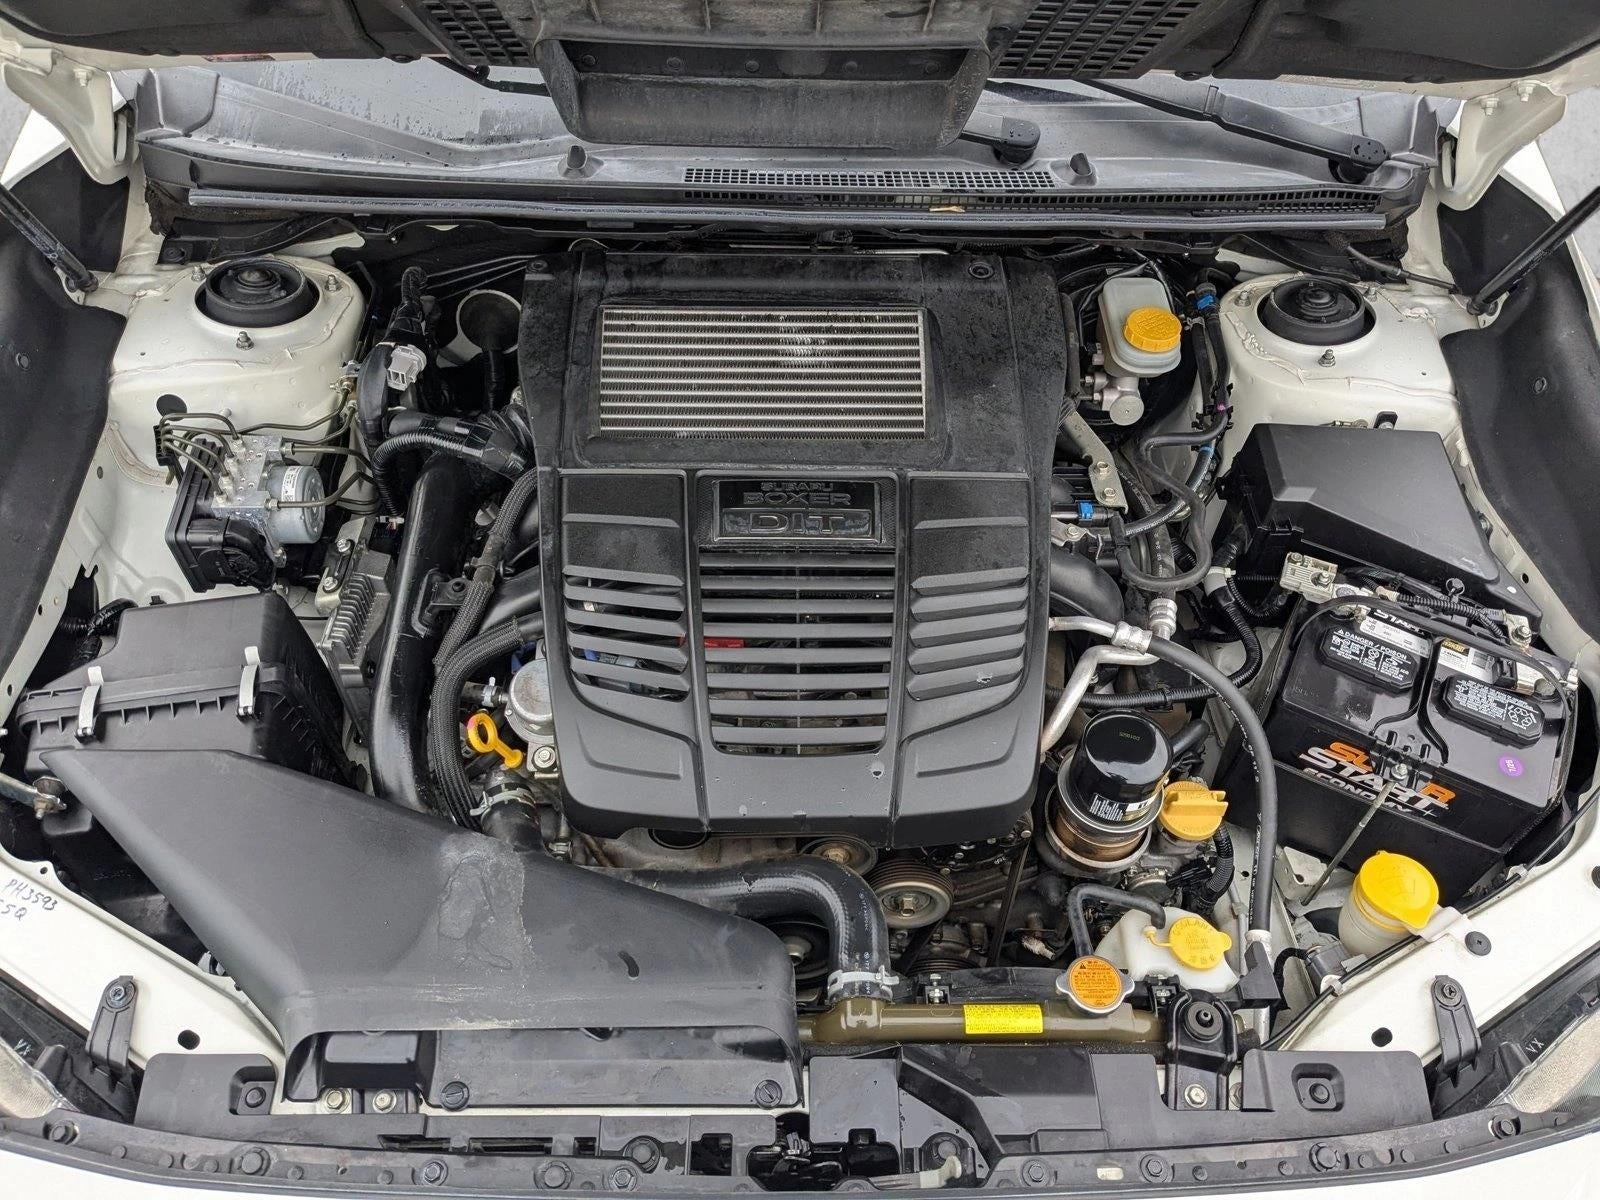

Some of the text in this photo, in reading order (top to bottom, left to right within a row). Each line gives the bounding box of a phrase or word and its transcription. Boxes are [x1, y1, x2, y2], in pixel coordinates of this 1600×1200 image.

[760, 482, 834, 492] SUBARU
[743, 492, 851, 505] BOXER
[1344, 631, 1374, 647] DANGER
[1380, 645, 1408, 660] POISON
